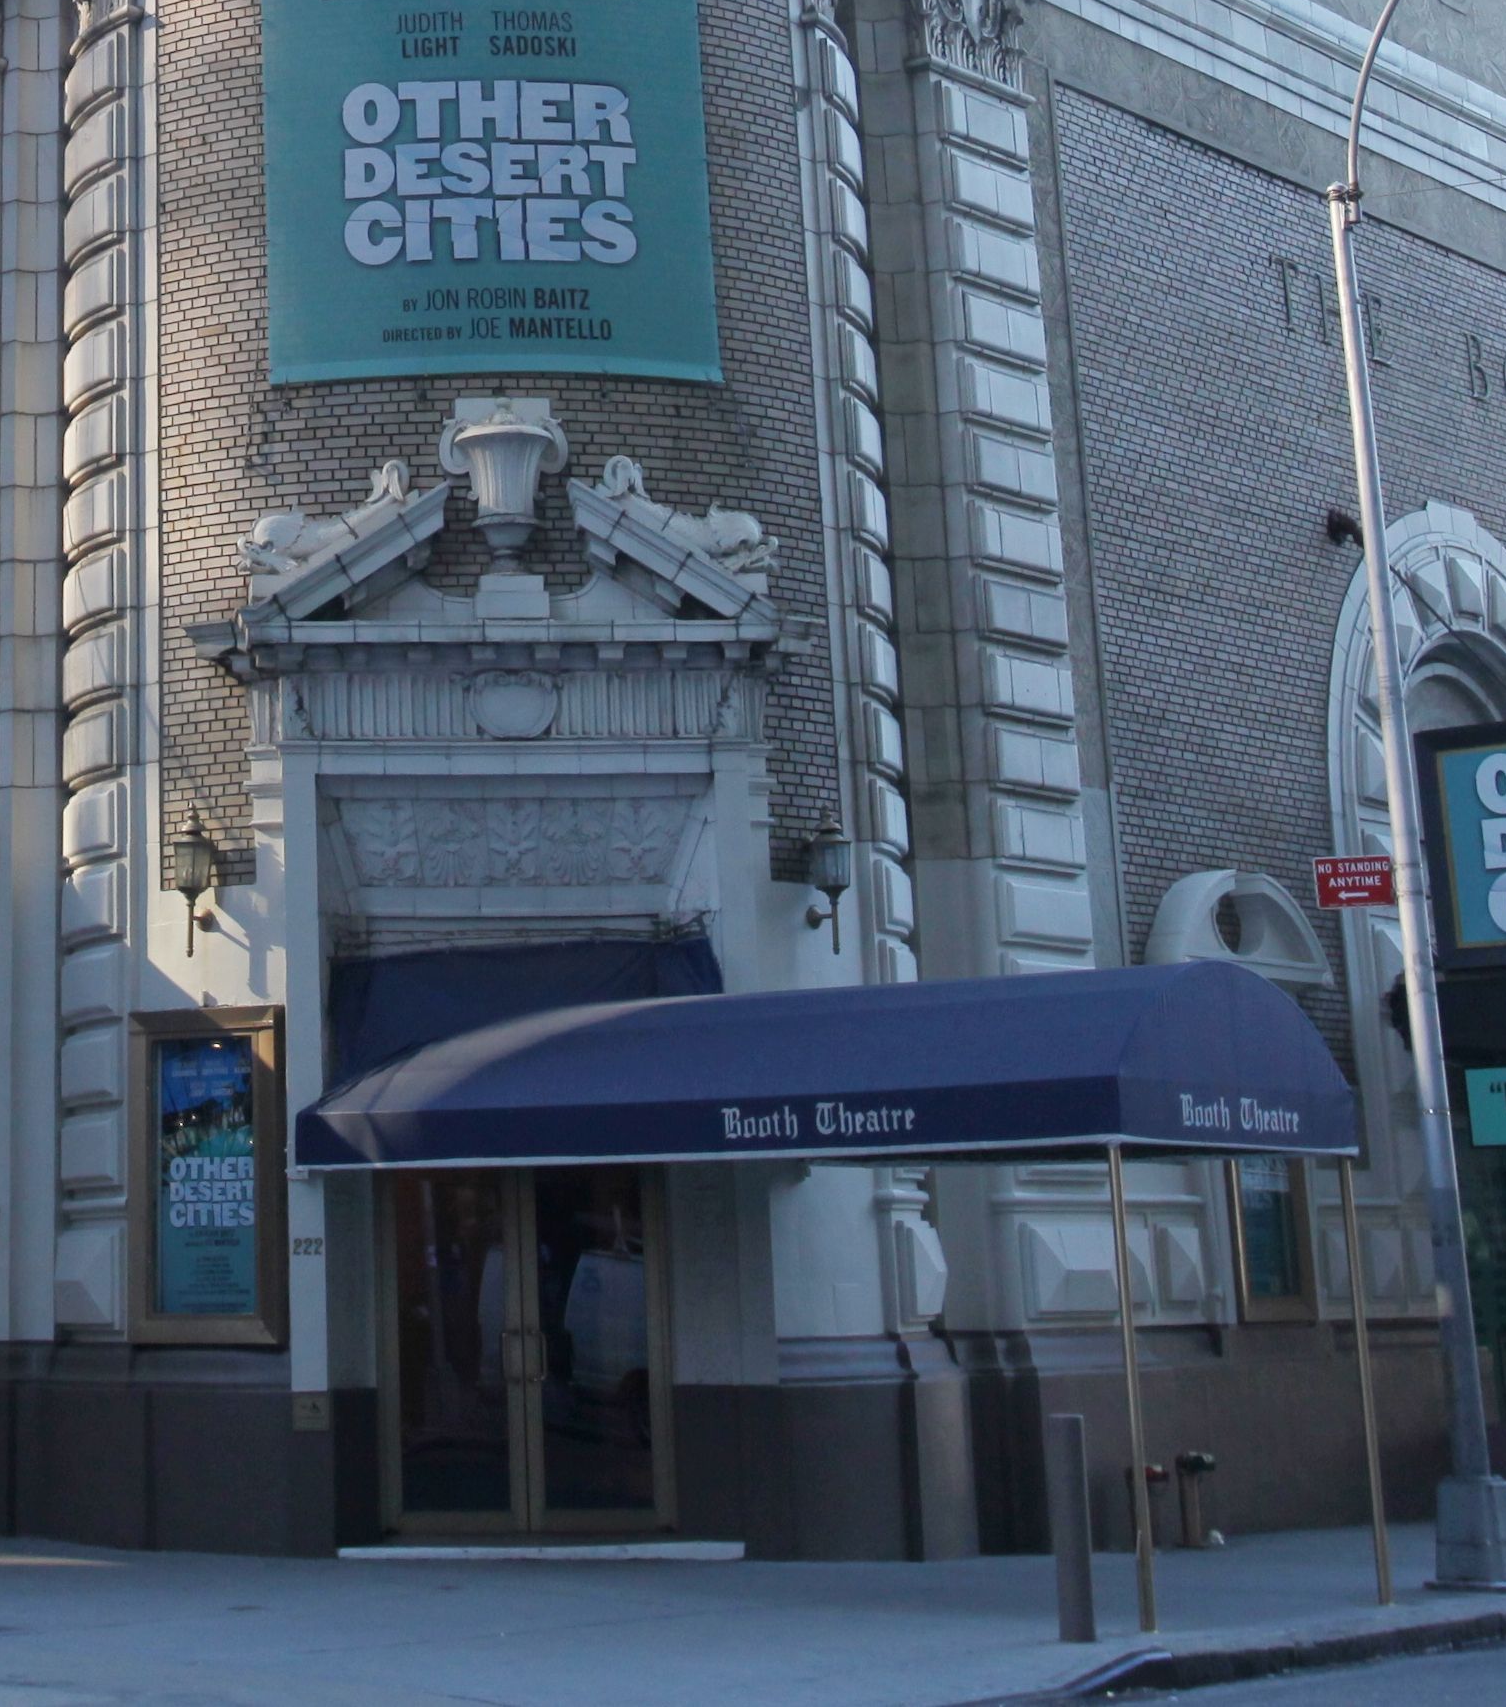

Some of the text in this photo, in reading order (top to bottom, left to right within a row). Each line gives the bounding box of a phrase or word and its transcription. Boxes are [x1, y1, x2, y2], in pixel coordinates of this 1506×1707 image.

[396, 11, 464, 35] JUDITH
[490, 10, 573, 32] THOMAS
[401, 37, 461, 59] LIGHT
[489, 36, 577, 57] SADOSKI
[342, 80, 633, 144] OTHER
[344, 142, 637, 199] DESERT
[344, 198, 637, 266] CITIES
[402, 287, 590, 313] BY JON ROBIN BAITZ
[1269, 253, 1395, 368] THE
[382, 317, 612, 343] DIRECTED BY JOE MANTELLO
[1318, 861, 1389, 874] NO STANDING
[1329, 875, 1382, 888] ANYTIME
[721, 1102, 916, 1141] Booth Theatre
[1180, 1094, 1301, 1134] Booth Theatre
[169, 1156, 255, 1181] OTHER
[169, 1181, 255, 1203] DESERT
[169, 1202, 255, 1228] CITIES
[293, 1237, 324, 1256] 222
